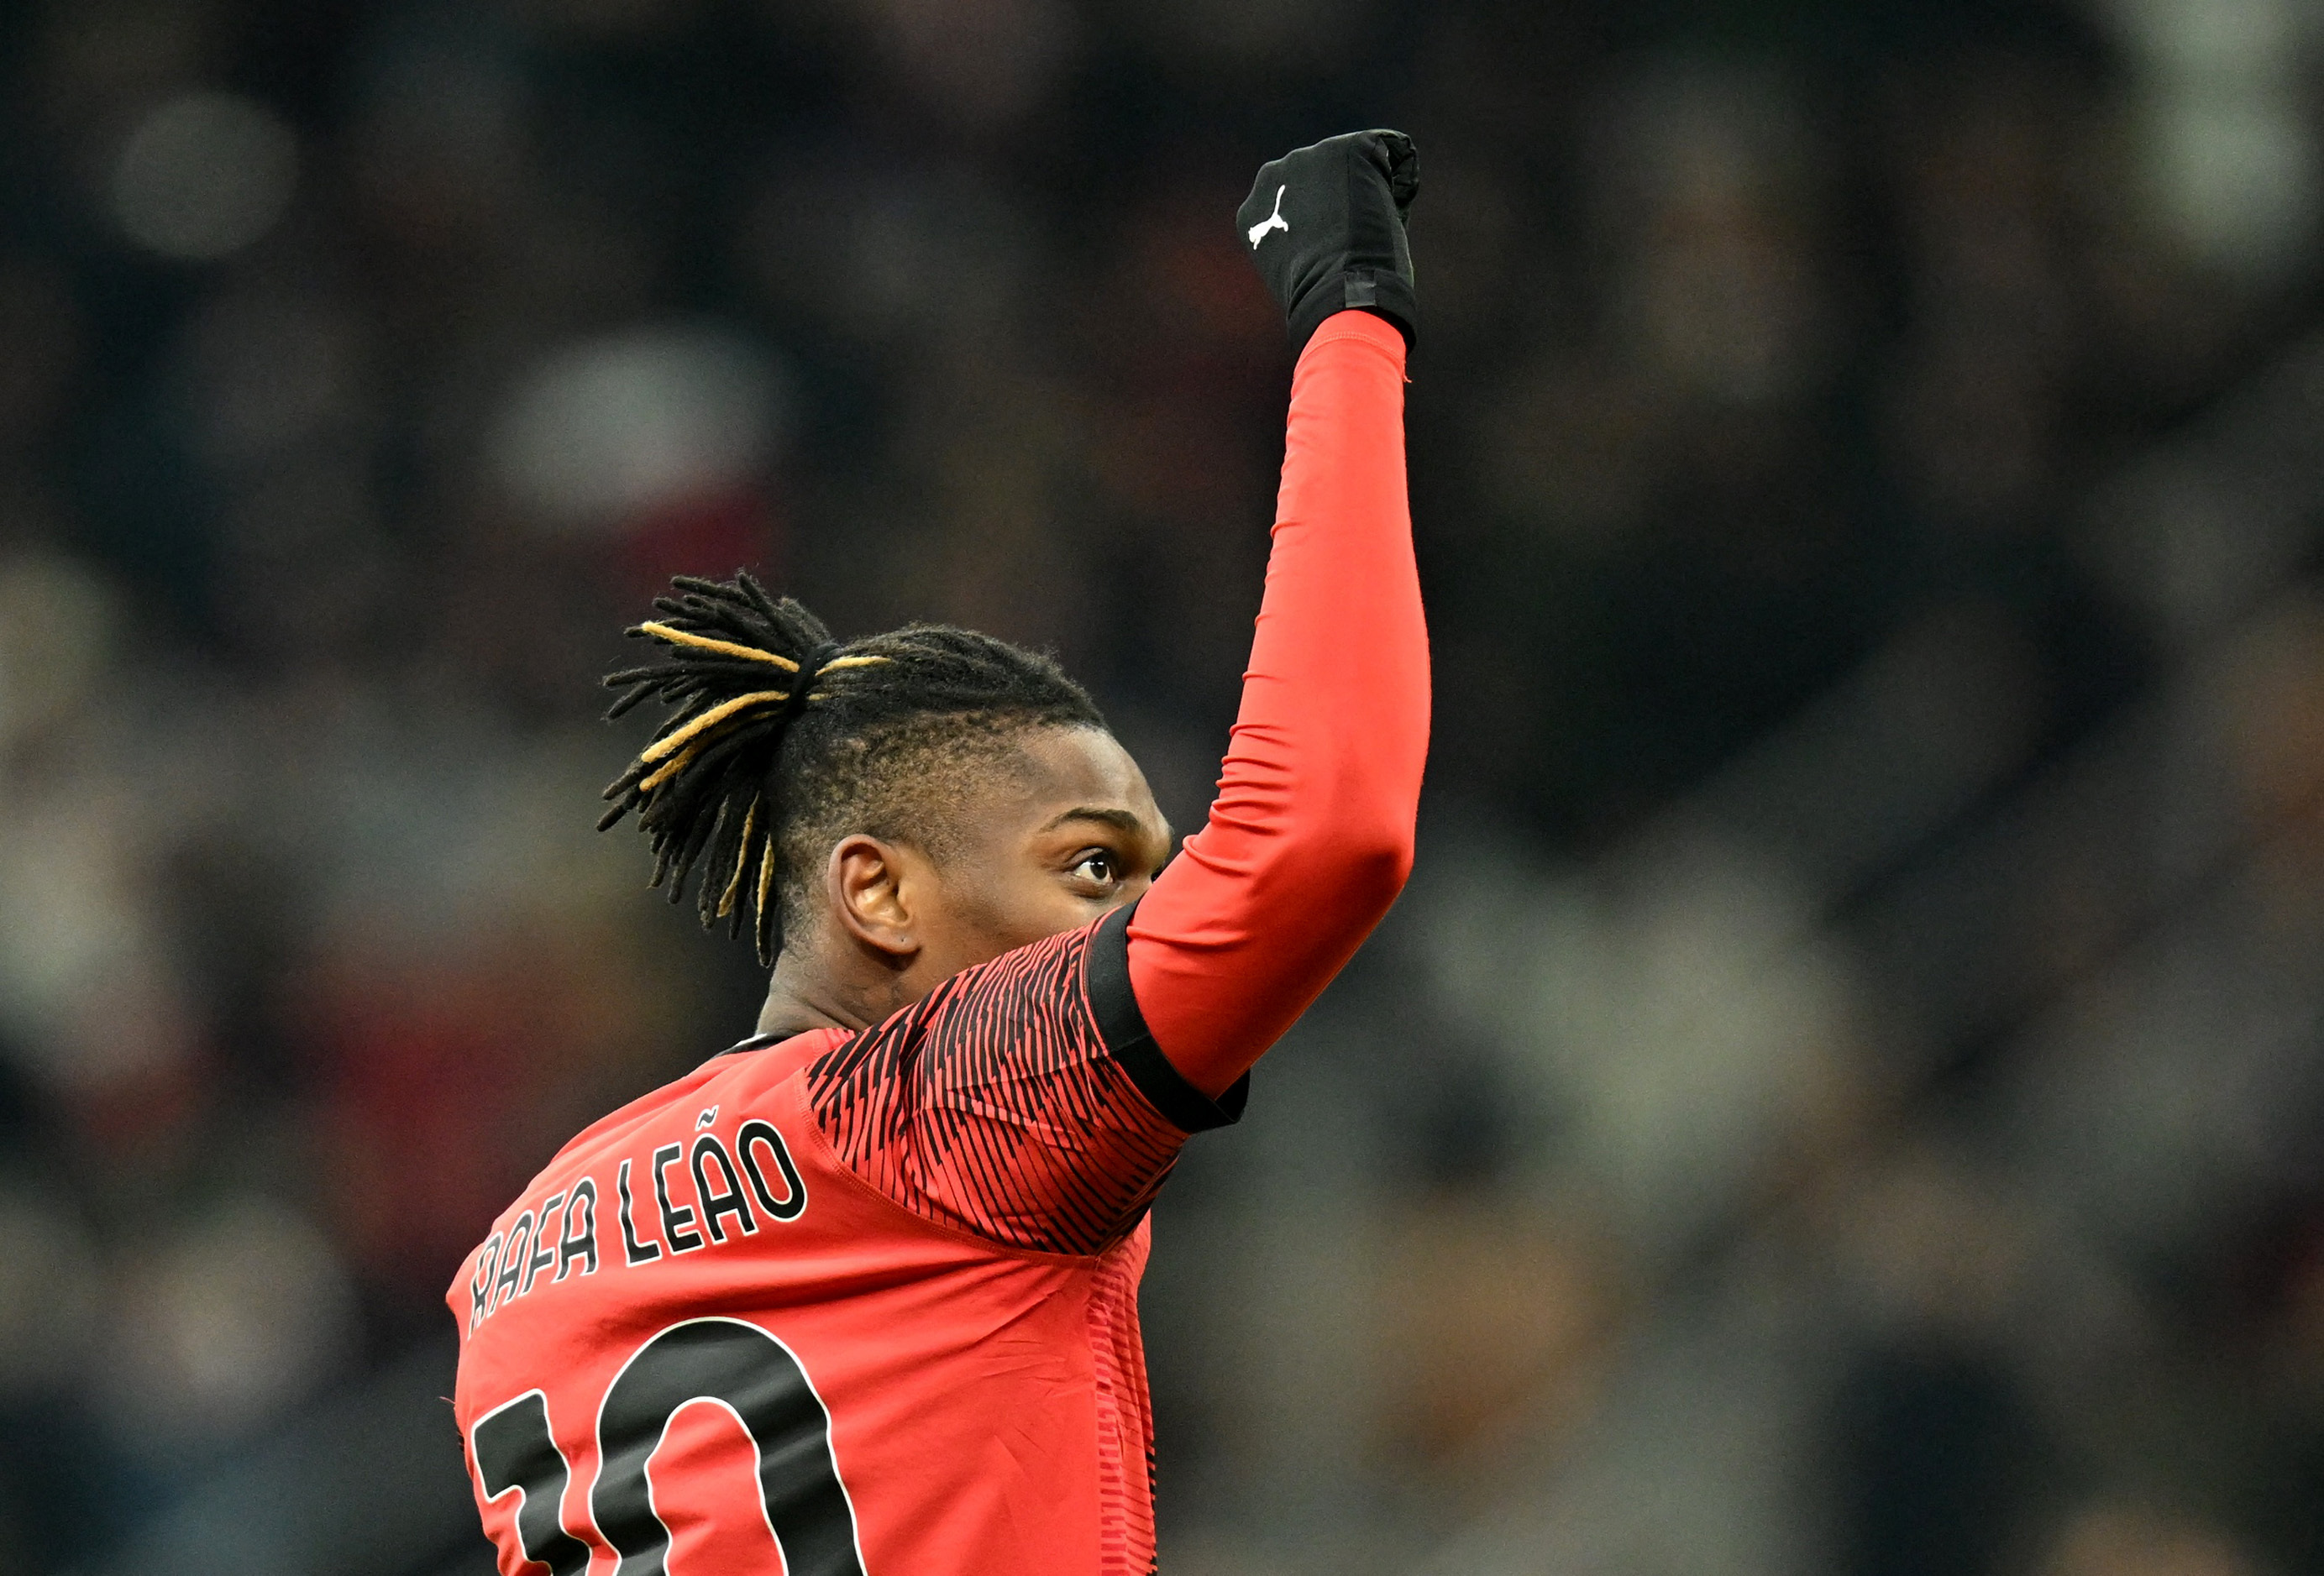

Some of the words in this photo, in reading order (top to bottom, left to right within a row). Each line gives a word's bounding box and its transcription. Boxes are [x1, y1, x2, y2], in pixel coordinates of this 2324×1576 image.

[468, 1176, 599, 1341] RAFA
[617, 1105, 807, 1268] LEÃO
[471, 1317, 868, 1576] 10
